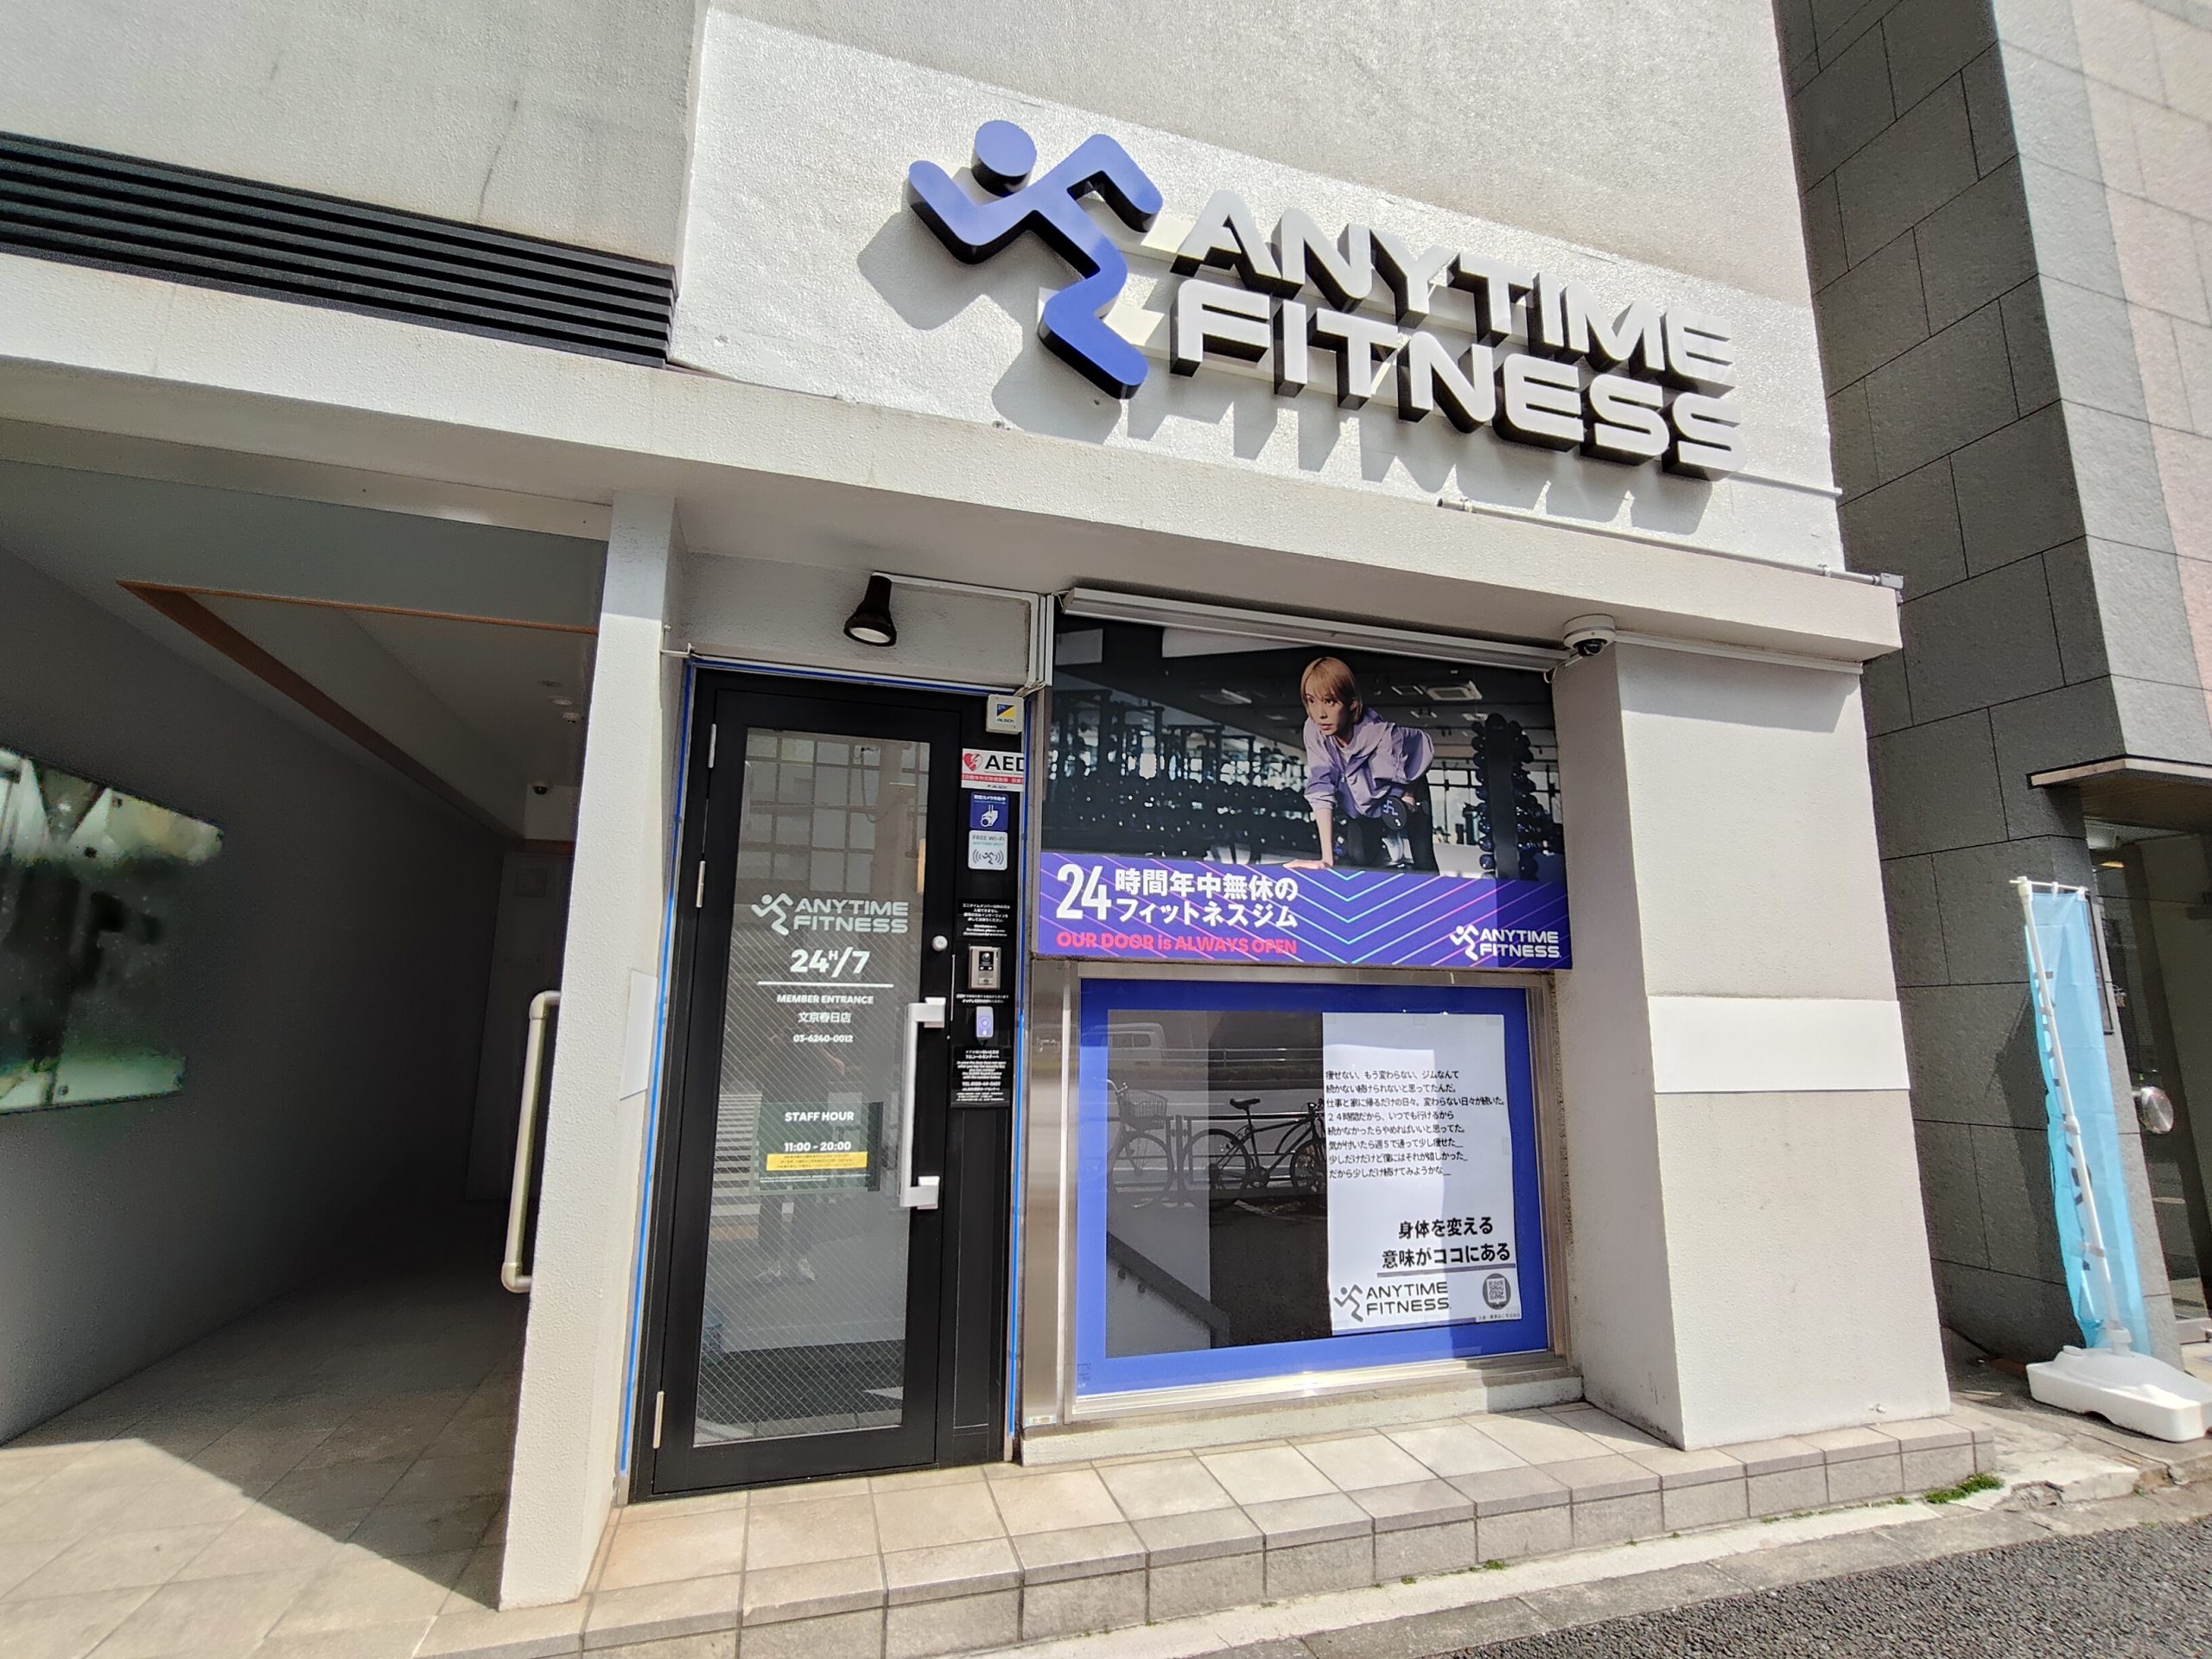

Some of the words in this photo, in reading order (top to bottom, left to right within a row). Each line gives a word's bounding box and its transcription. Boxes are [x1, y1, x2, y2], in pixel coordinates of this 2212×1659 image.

[1173, 188, 1735, 393] ANYTIME
[1170, 278, 1746, 480] FITNESS
[1055, 863, 1112, 920] 24
[1115, 868, 1298, 902] 時間年中無休の
[794, 898, 909, 916] ANYTIME
[1116, 898, 1298, 928] フィットネスジム
[793, 915, 909, 933] FITNESS
[1056, 931, 1096, 948] OUR
[1101, 932, 1154, 950] DOOR
[1158, 935, 1172, 950] is
[1175, 936, 1249, 952] ALWAYS
[1251, 938, 1298, 954] OPEN
[1480, 929, 1559, 944] ANYTIME
[1480, 943, 1560, 958] FITNESS
[777, 994, 820, 1003] MEMBER
[821, 995, 874, 1004] ENTRANCE
[785, 1111, 820, 1122] STAFF
[822, 1111, 855, 1121] HOUR
[784, 1142, 811, 1152] 11:00
[820, 1141, 851, 1151] 20:00
[1398, 1217, 1493, 1239] 身体を変える
[1382, 1243, 1510, 1269] 意味がココにある
[1366, 1281, 1448, 1300] ANYTIME
[1366, 1297, 1450, 1316] FITNESS
